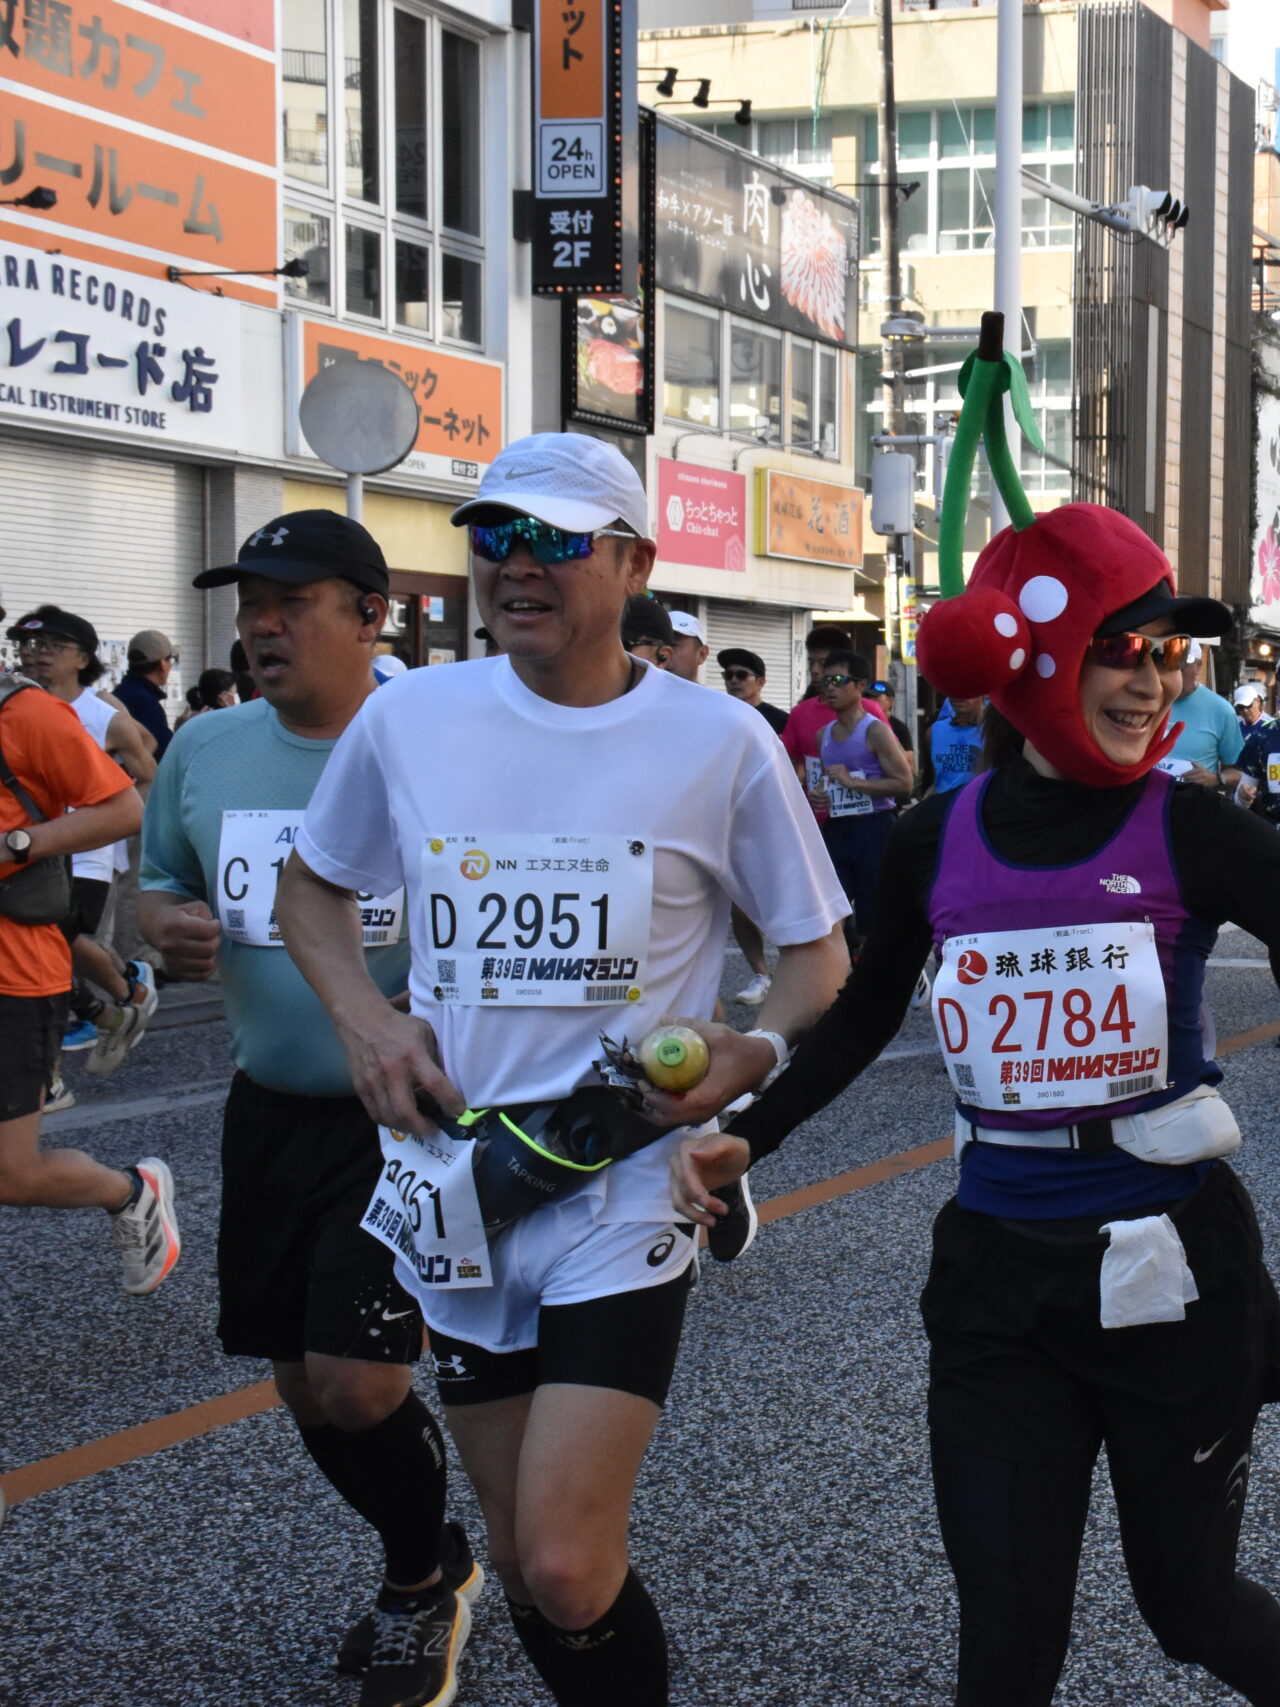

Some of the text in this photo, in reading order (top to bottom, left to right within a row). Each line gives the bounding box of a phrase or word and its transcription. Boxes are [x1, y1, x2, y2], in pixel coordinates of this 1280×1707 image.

[561, 0, 585, 70] ット
[551, 137, 593, 162] 24h
[547, 164, 596, 181] OPEN
[549, 210, 594, 235] 受付
[552, 241, 591, 269] 2F
[0, 255, 167, 337] RA RECORDS
[7, 317, 219, 414] レコード店
[30, 389, 121, 421] INSTRUMENT
[125, 406, 167, 430] STORE
[417, 404, 490, 447] ーネット
[275, 826, 298, 844] A
[223, 857, 249, 901] C
[496, 858, 610, 873] NN エヌエヌ生命
[1111, 873, 1128, 882] THE
[1100, 878, 1128, 889] NORTH
[1106, 885, 1128, 894] FACE
[430, 892, 609, 950] D 2951
[994, 943, 1130, 979] 琉球銀行
[938, 984, 1136, 1054] D 2784
